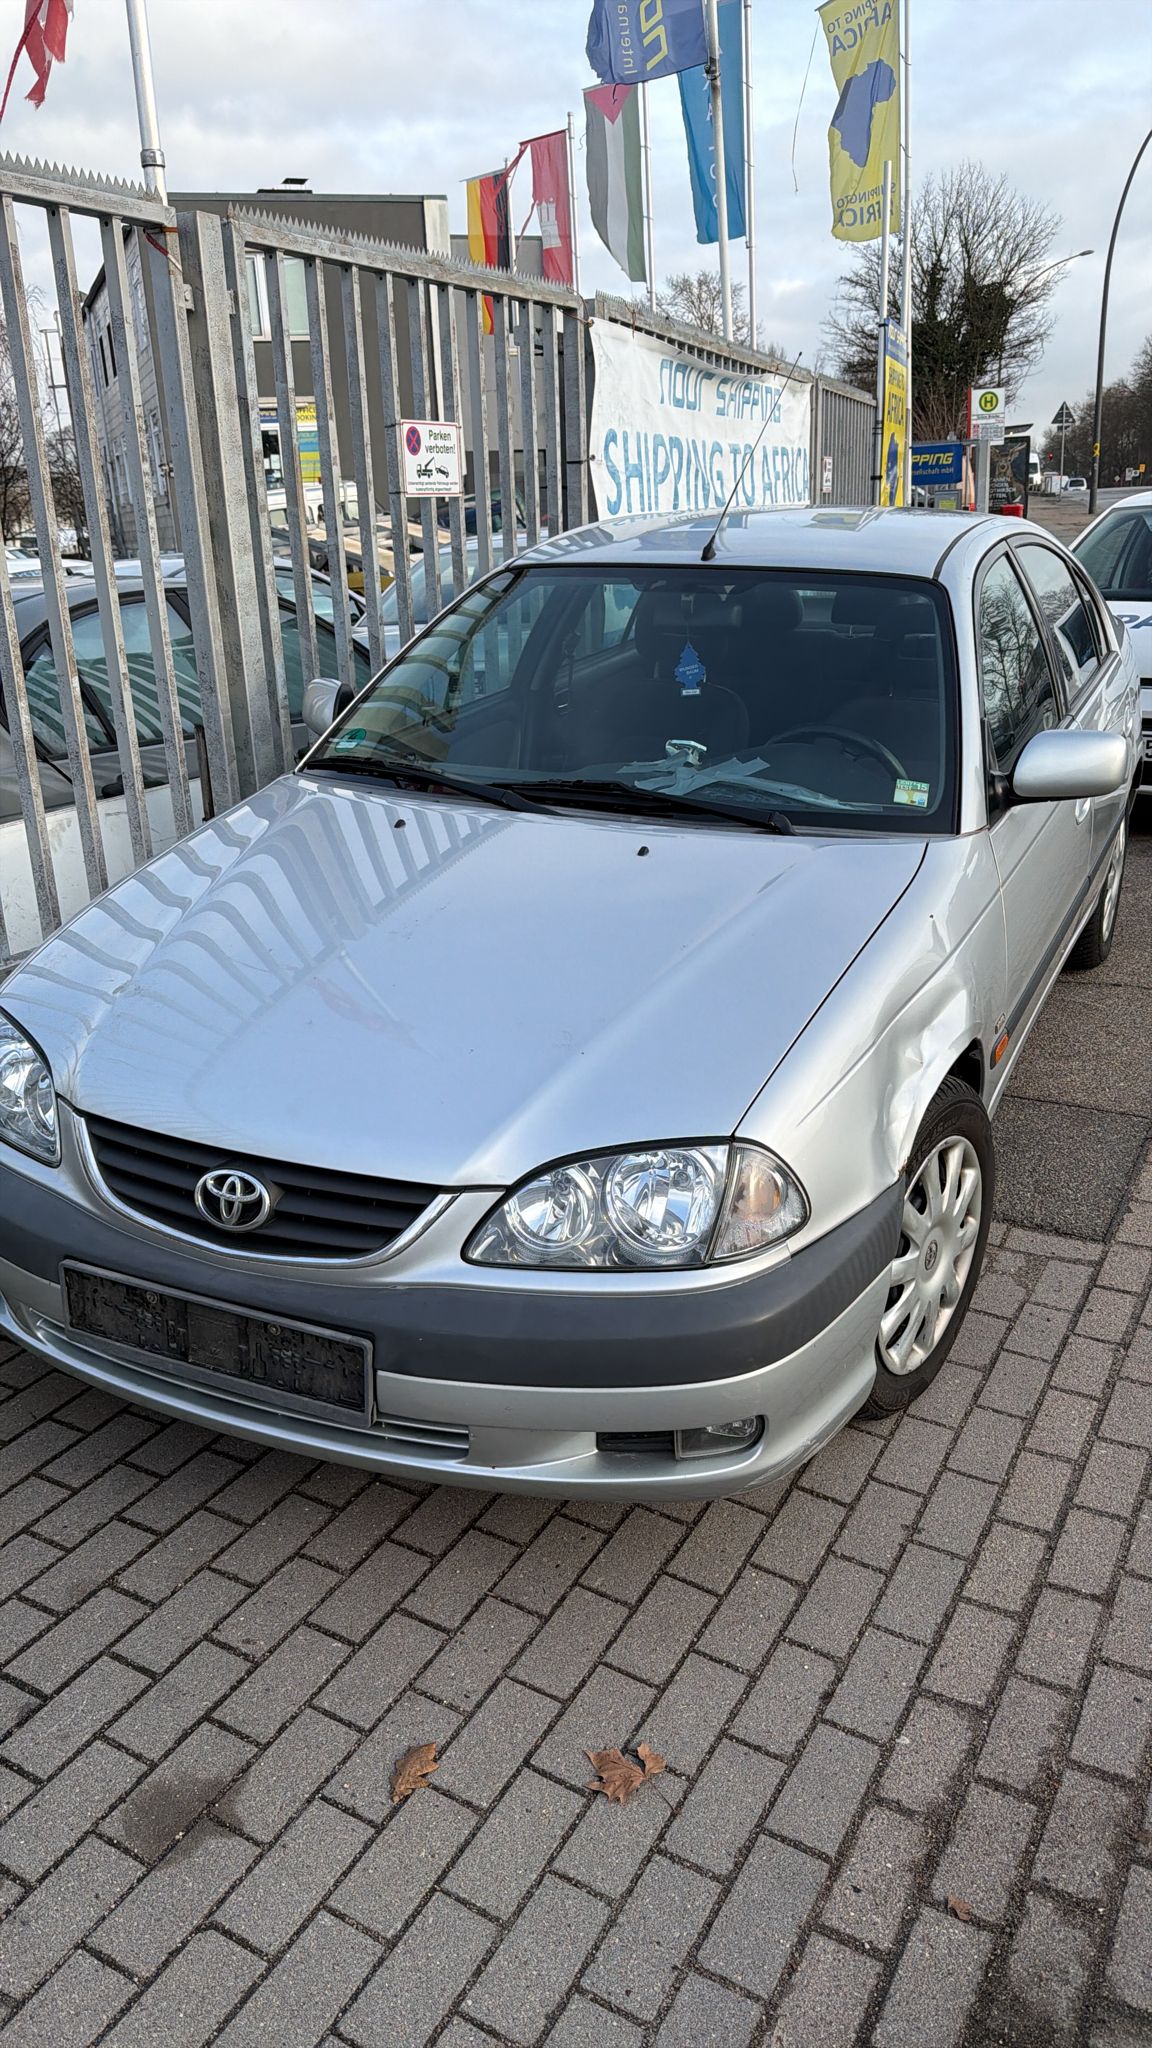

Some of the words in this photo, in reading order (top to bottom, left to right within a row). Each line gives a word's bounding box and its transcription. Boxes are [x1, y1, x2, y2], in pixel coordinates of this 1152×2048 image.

[716, 377, 781, 423] SHIPPING
[425, 444, 456, 454] verboten!
[428, 430, 451, 441] Parken
[604, 428, 727, 515] SHIPPING
[728, 443, 755, 507] TO
[762, 445, 809, 505] AFRICA
